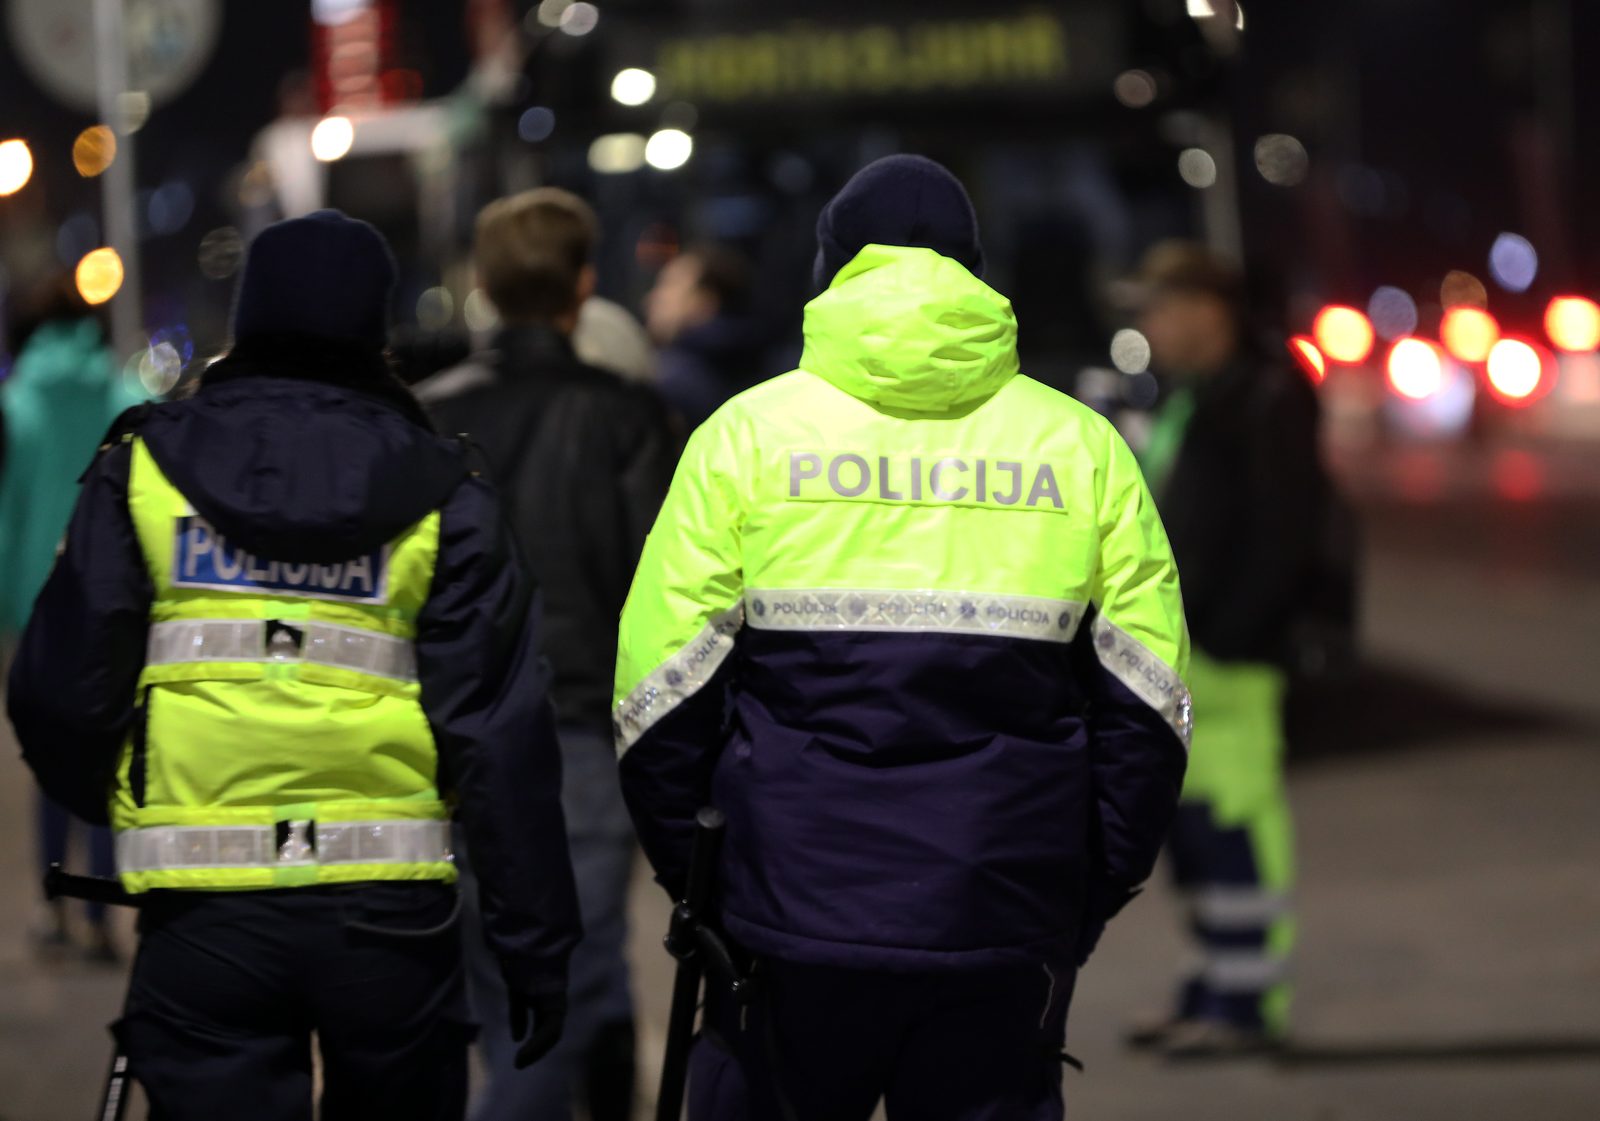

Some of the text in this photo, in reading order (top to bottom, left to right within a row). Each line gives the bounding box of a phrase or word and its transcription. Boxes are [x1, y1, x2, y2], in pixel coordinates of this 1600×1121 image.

[789, 452, 1064, 508] POLICIJA
[878, 601, 947, 615] POLICIJA
[986, 605, 1049, 624] POLICIJA
